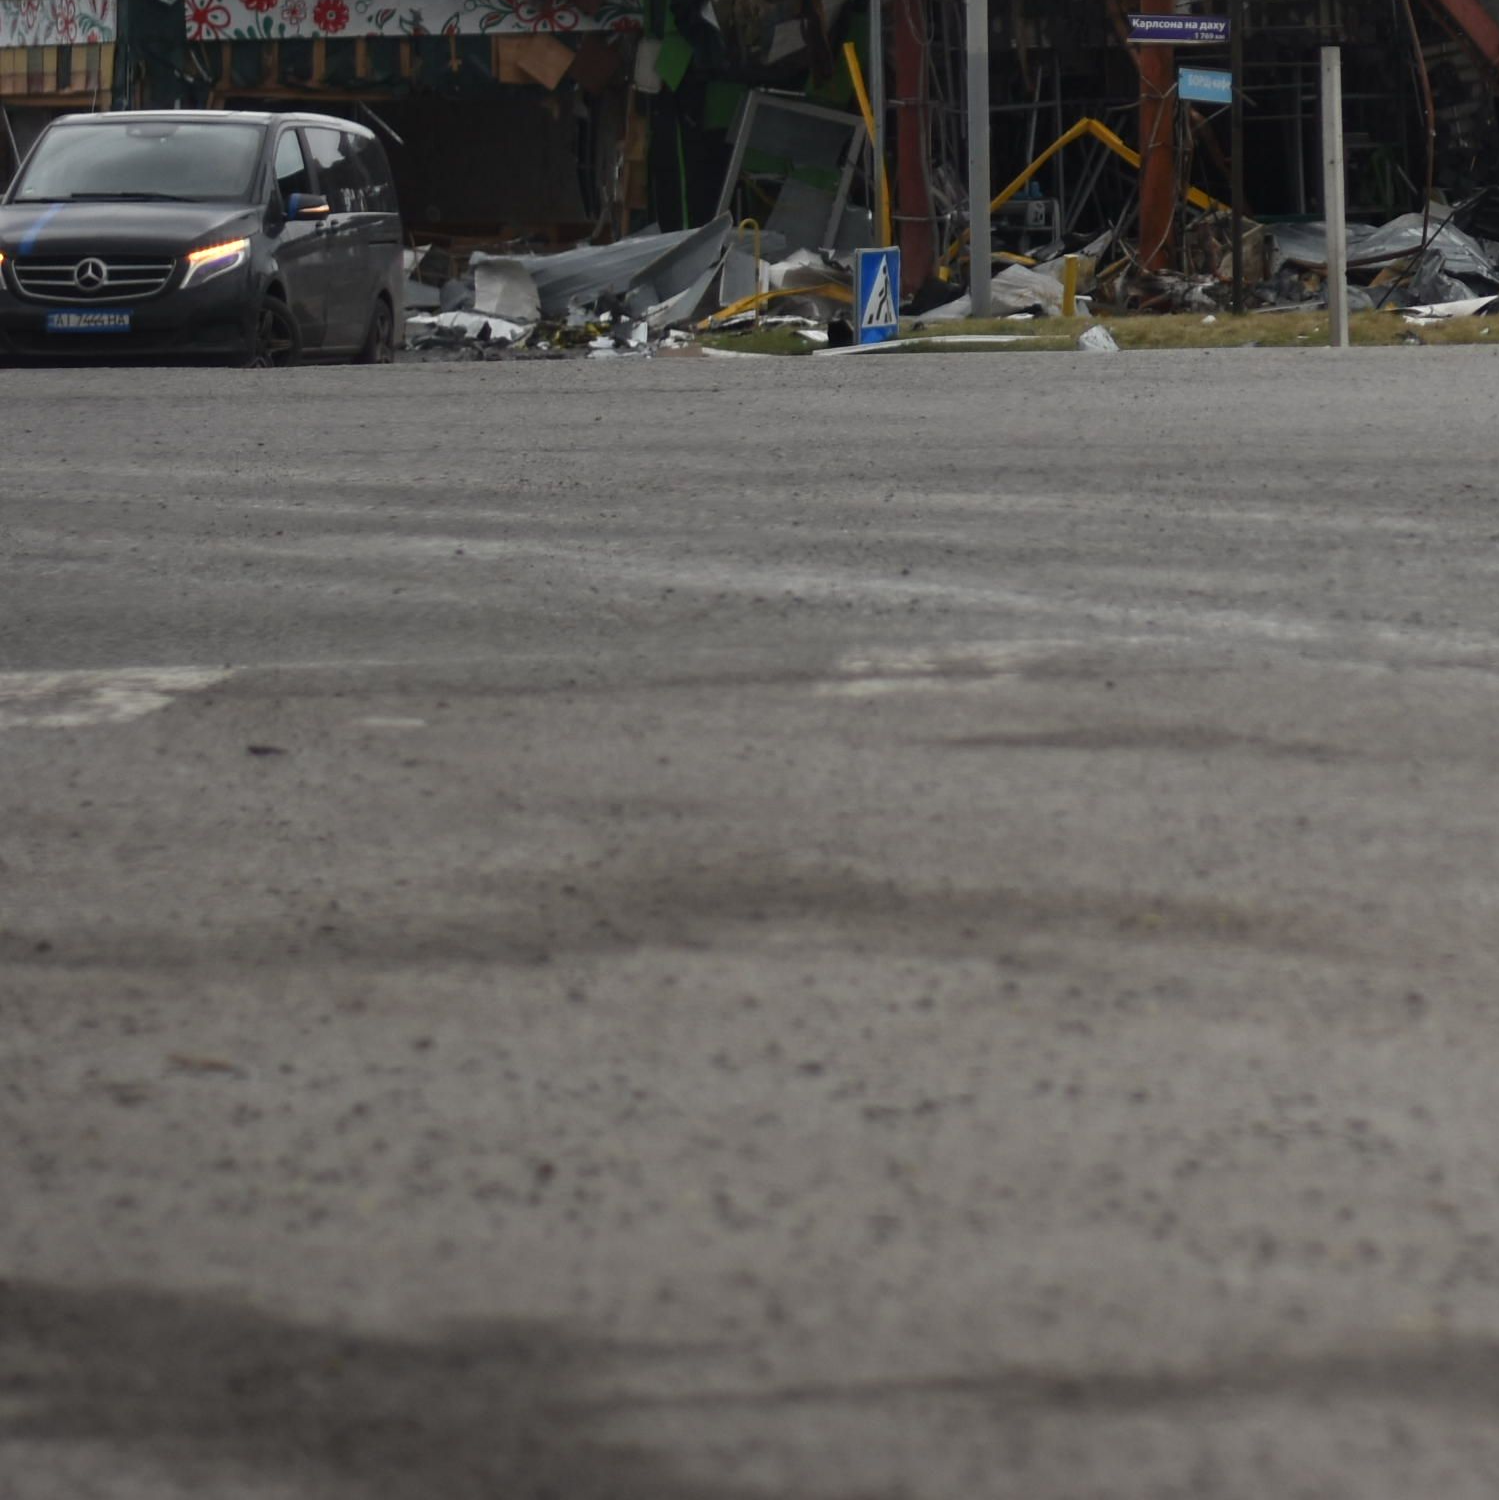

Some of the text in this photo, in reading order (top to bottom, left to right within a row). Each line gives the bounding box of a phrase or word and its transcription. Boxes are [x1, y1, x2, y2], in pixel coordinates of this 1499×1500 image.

[1132, 18, 1225, 31] Карлсона на даху
